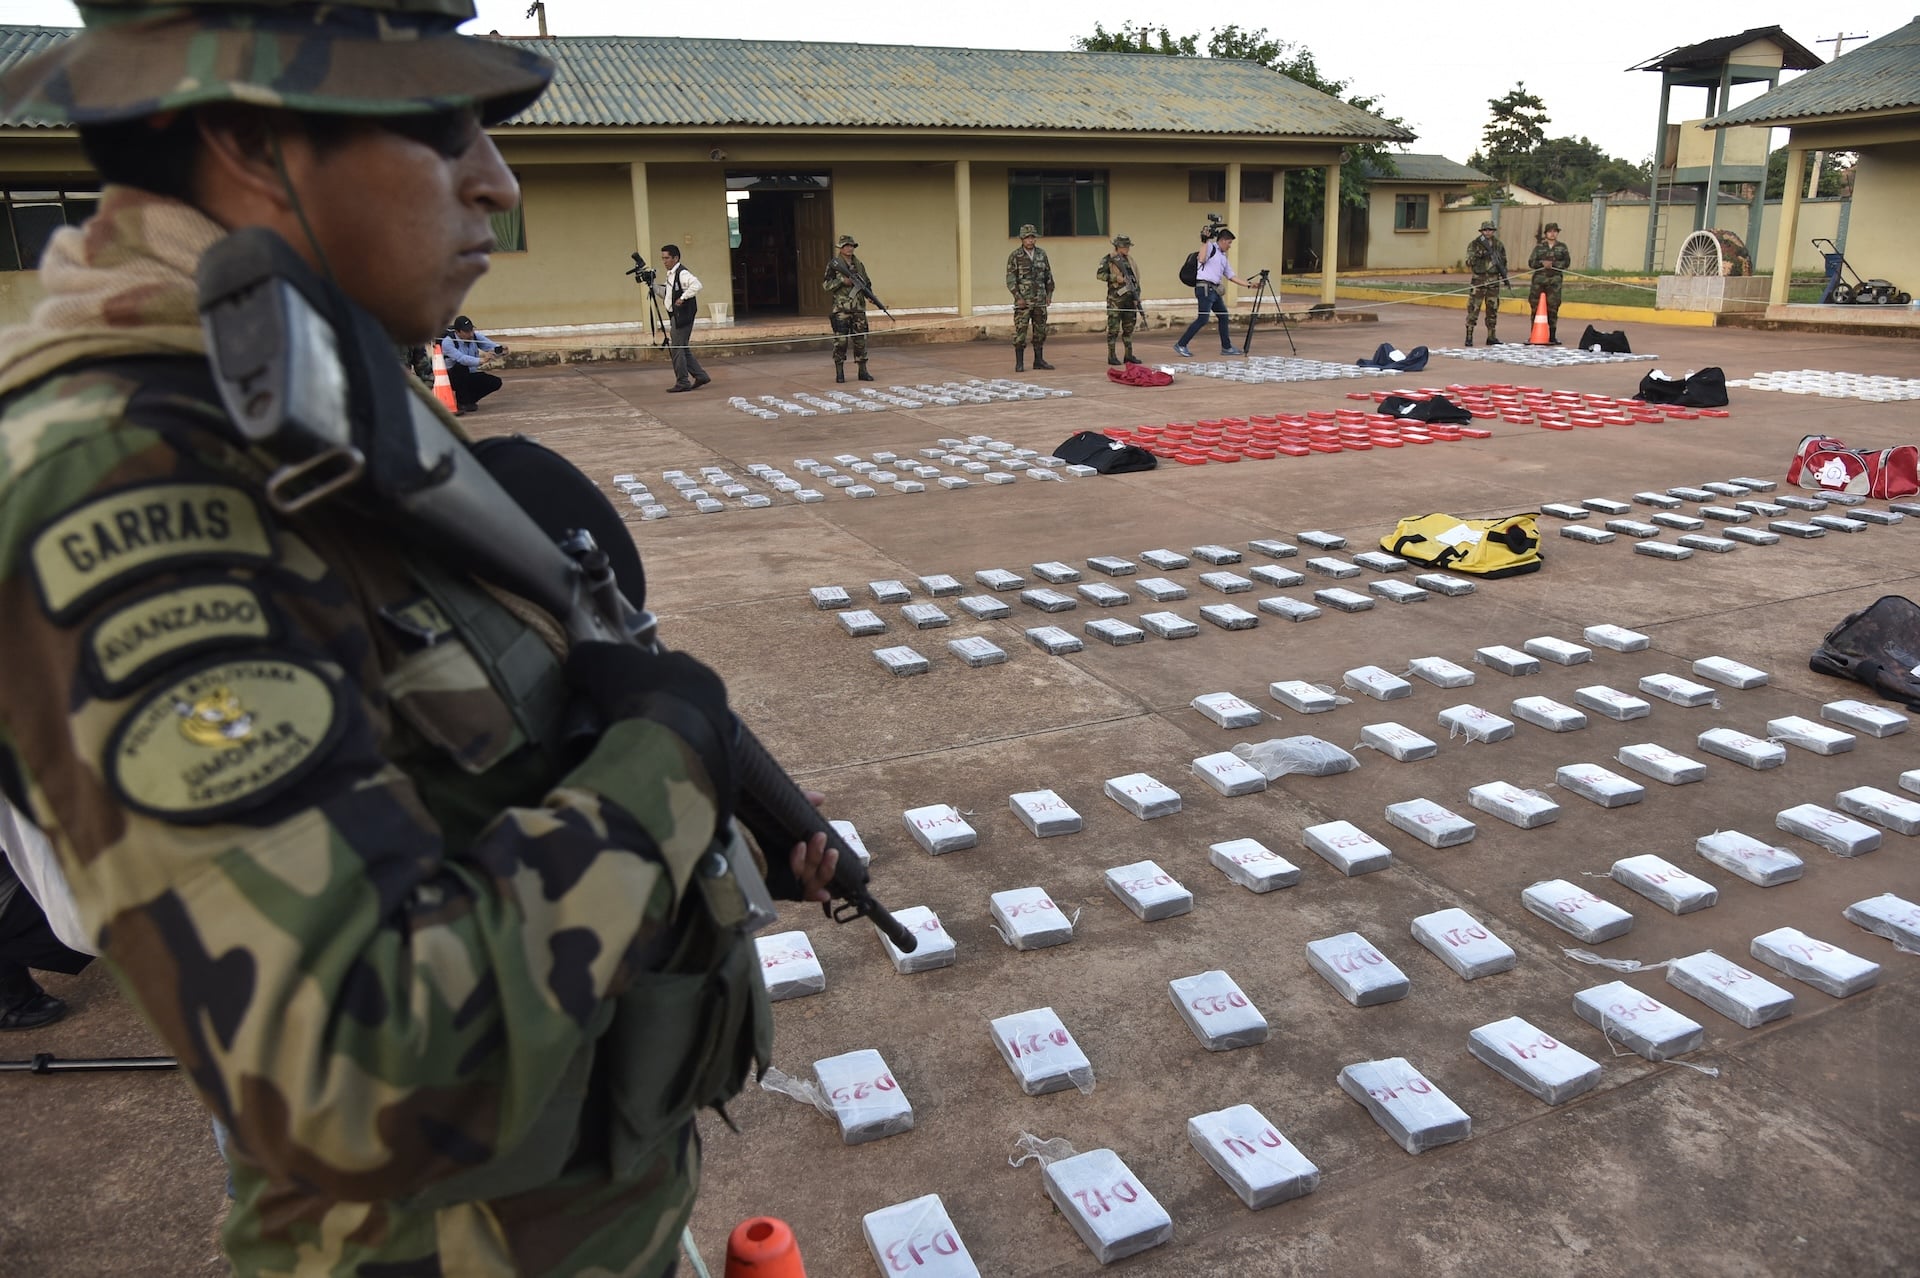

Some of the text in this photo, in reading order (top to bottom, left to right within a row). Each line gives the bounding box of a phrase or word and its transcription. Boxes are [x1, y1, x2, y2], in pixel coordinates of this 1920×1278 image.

[61, 501, 231, 574] GARRAS
[103, 599, 259, 666] AVANZADO
[1329, 832, 1374, 848] D-33
[1121, 874, 1173, 895] D-35
[1442, 926, 1488, 948] D-21
[1330, 947, 1384, 974] D-22
[1191, 991, 1248, 1017] D-23
[1609, 999, 1661, 1021] D-8
[832, 1072, 897, 1104] D-25
[1072, 1180, 1139, 1218] D-12
[885, 1228, 960, 1272] D-13
